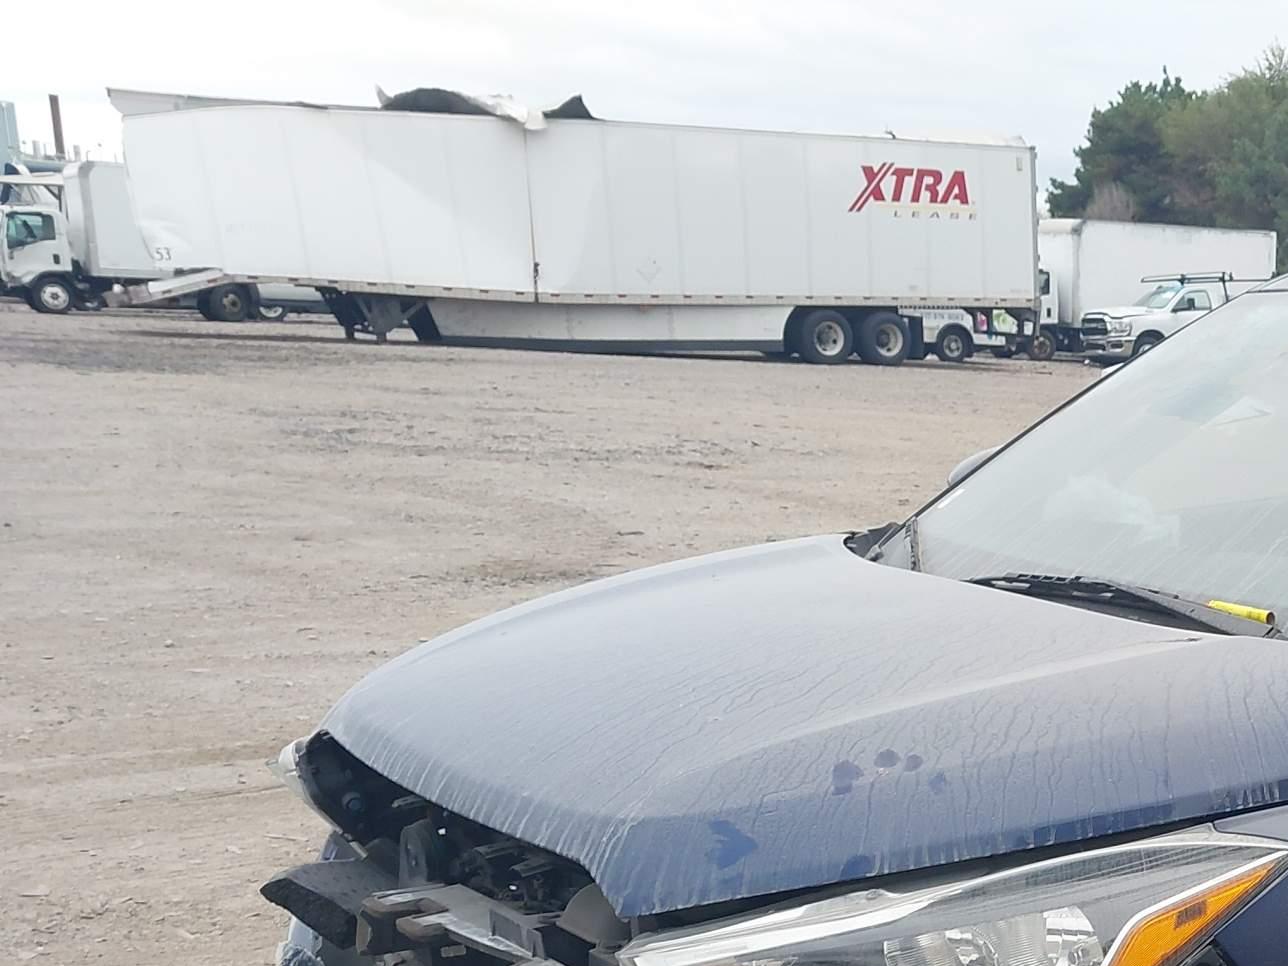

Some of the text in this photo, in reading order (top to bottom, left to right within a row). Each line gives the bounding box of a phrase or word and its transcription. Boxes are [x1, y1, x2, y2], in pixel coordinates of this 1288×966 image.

[848, 162, 970, 212] XTRA
[893, 210, 977, 221] LEASE
[155, 246, 172, 261] 53
